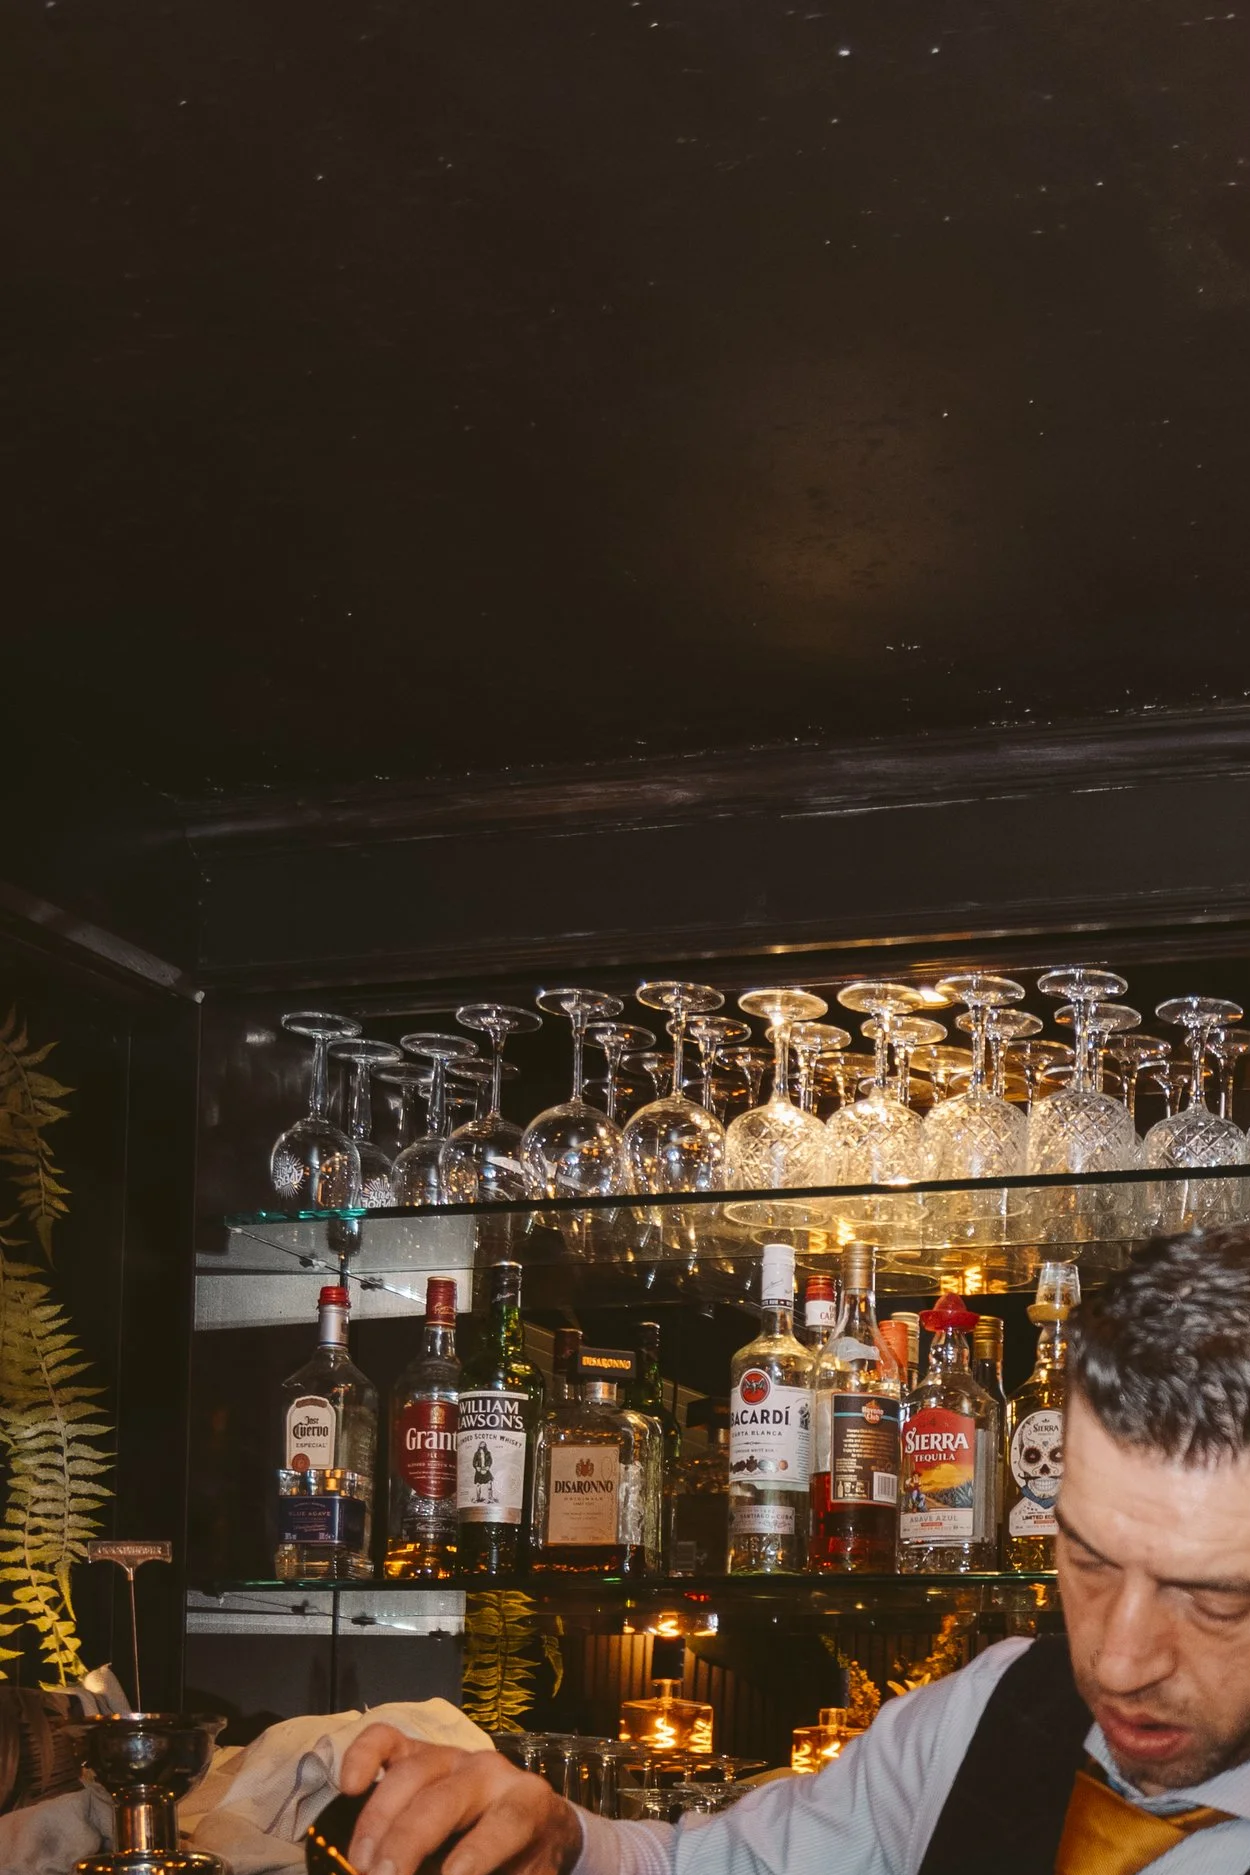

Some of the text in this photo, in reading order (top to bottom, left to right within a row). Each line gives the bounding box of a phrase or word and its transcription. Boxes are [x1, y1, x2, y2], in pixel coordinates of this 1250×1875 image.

[582, 1356, 632, 1370] DISARONNO
[460, 1399, 519, 1415] WILLIAM
[293, 1423, 329, 1440] Cuervo
[1033, 1423, 1059, 1434] SIERRA
[905, 1427, 969, 1454] SIERRA
[914, 1453, 956, 1462] TEQUILA
[554, 1480, 614, 1494] DISARONNO
